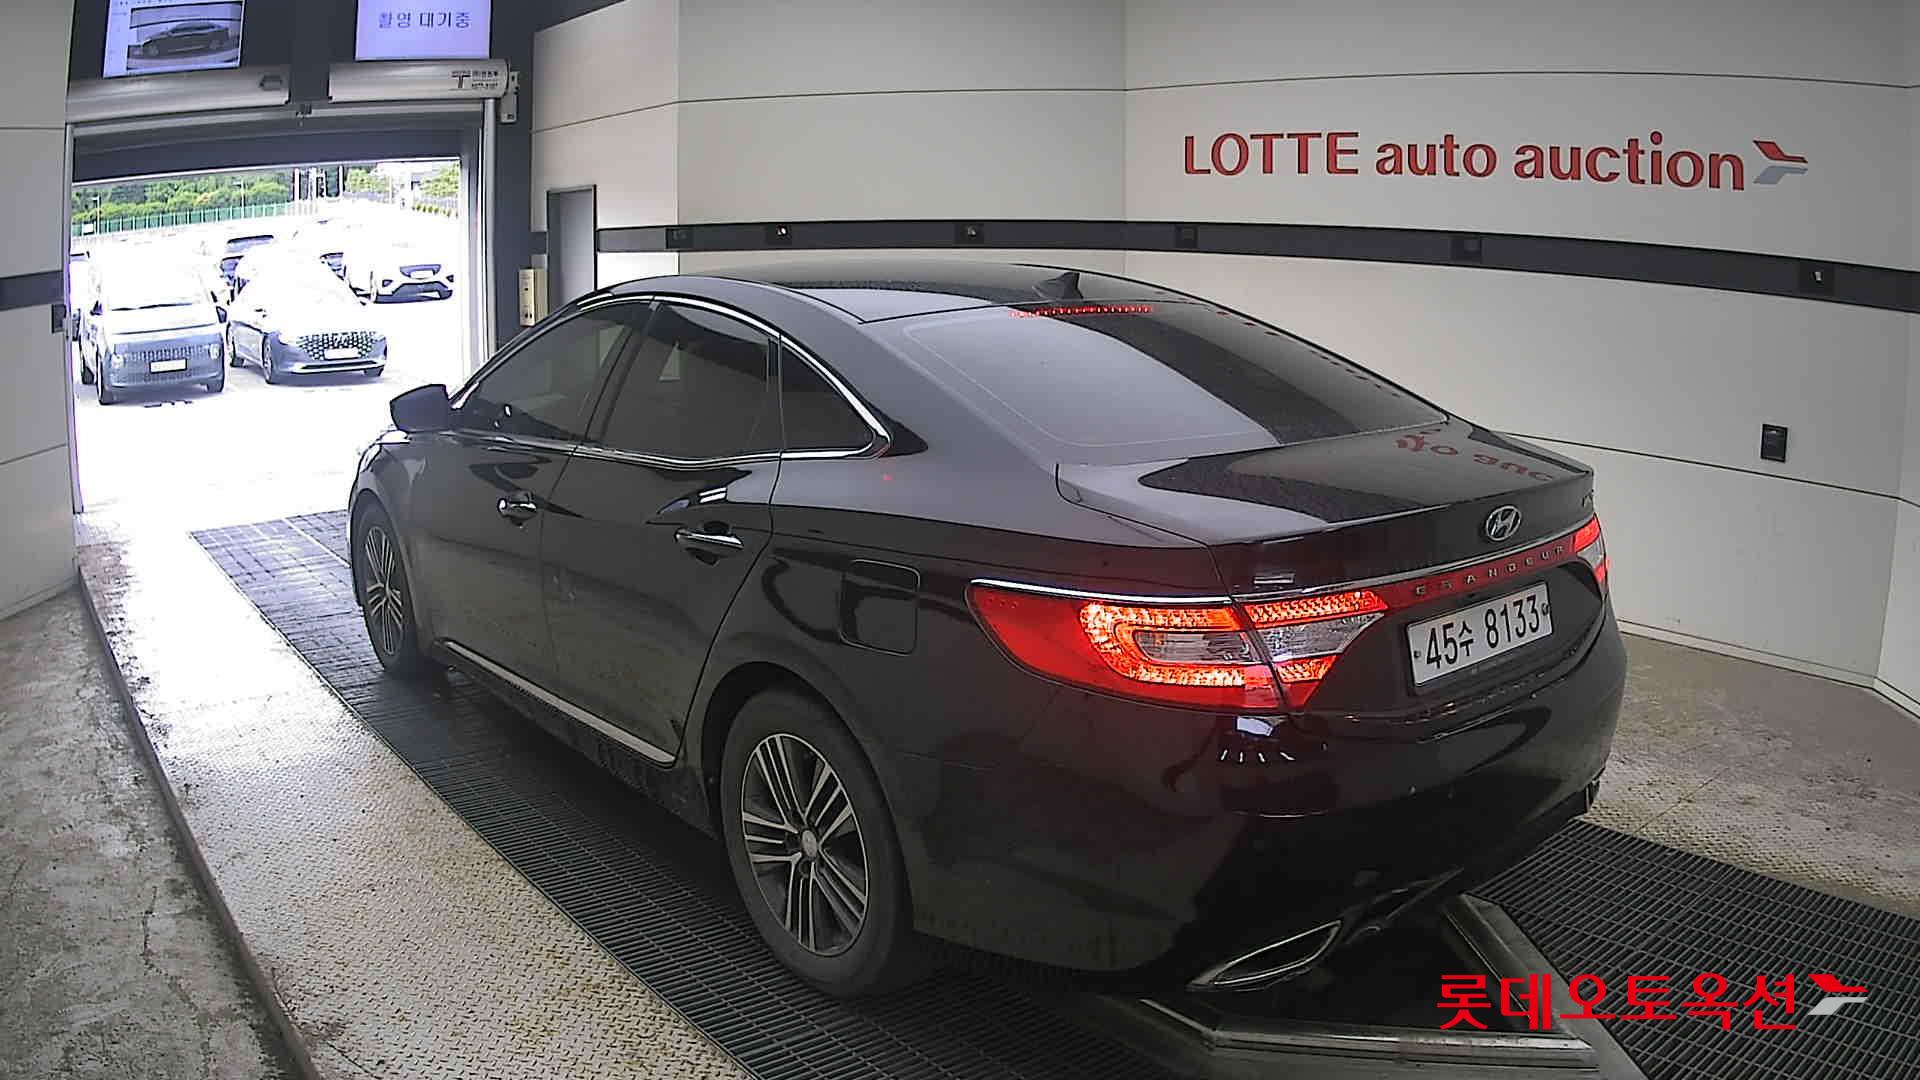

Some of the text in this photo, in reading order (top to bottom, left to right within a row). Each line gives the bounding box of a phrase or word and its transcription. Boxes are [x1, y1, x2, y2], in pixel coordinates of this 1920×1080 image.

[419, 11, 471, 29] 대기중
[1185, 131, 1745, 190] LOTTE auto auction
[1426, 595, 1540, 669] 45수 8133
